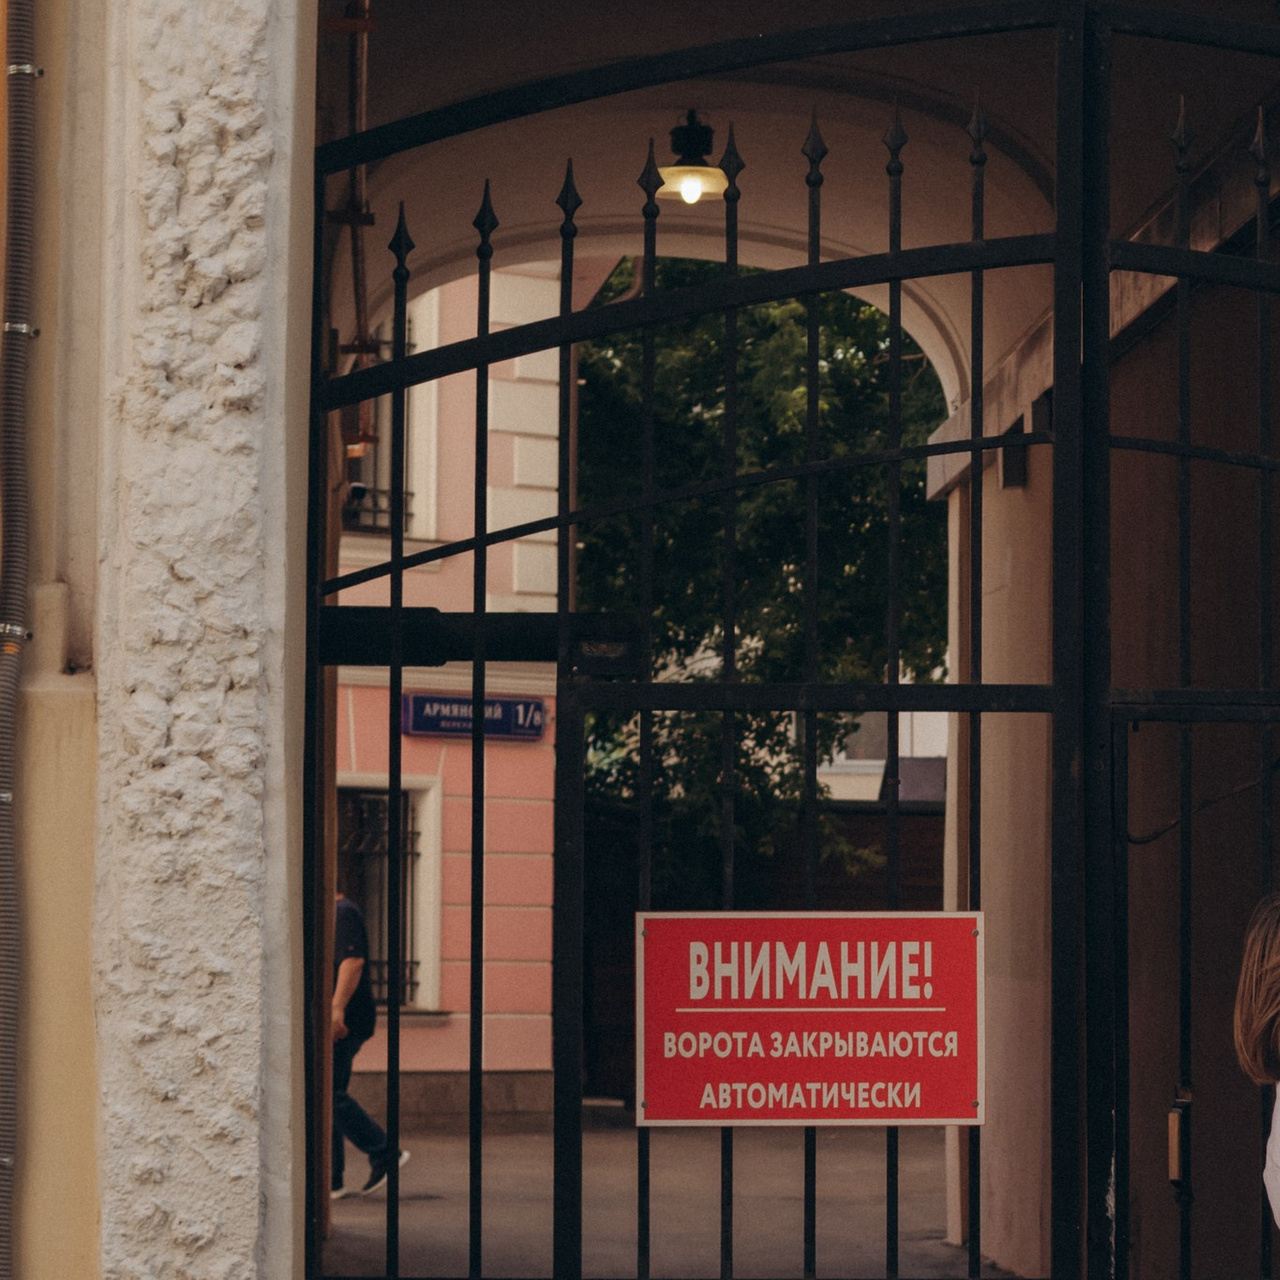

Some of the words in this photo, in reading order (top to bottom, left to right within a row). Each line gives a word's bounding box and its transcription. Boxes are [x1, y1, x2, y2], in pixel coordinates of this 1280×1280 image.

[689, 941, 933, 1000] ВНИМАНИЕ!
[664, 1032, 765, 1058] ВОРОТА
[770, 1031, 958, 1057] ЗАКРЫВАЮТСЯ
[700, 1082, 921, 1109] АВТОМАТИЧЕСКИ
